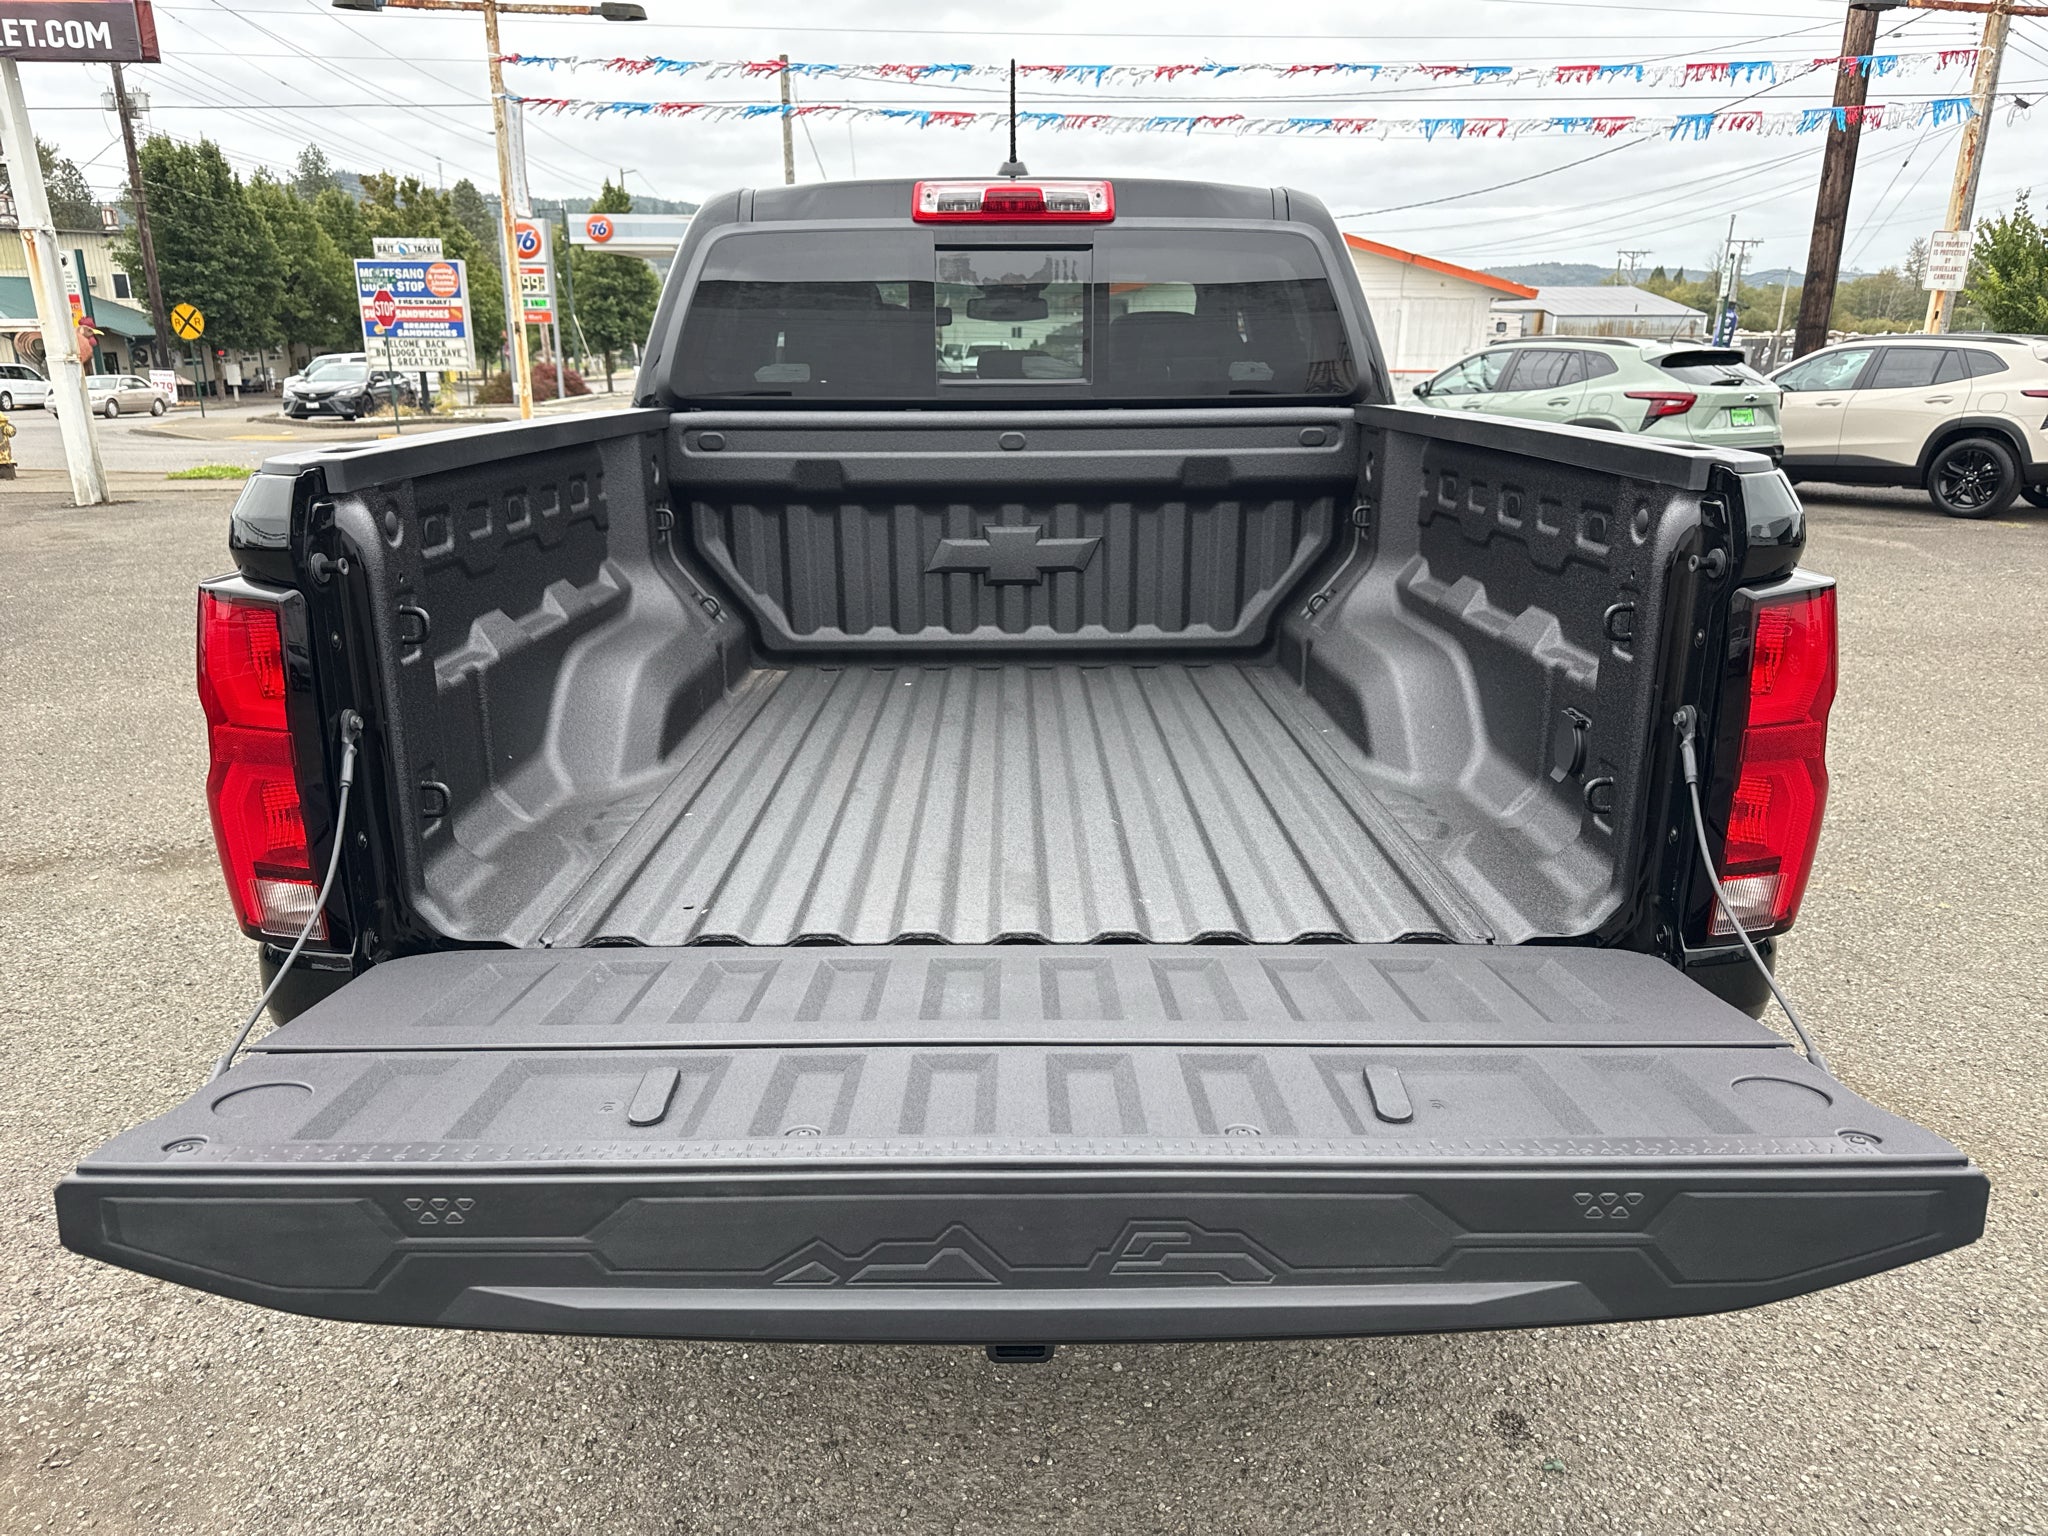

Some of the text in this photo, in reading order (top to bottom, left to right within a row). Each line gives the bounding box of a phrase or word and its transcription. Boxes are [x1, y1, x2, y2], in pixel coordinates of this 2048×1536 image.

[0, 19, 113, 50] ET.COM
[591, 222, 607, 236] 76
[377, 245, 440, 254] BAIT TACKLE
[1945, 241, 1969, 249] PROPERTY
[1939, 249, 1966, 257] PROTECTED
[1930, 265, 1963, 273] SURVEILLANCE
[397, 281, 425, 292] STOP
[374, 301, 395, 316] STOP
[395, 308, 450, 319] SANDWICHES
[174, 317, 201, 327] R R
[396, 328, 458, 337] SANDWICHES
[425, 340, 447, 348] BACK
[376, 348, 462, 357] BULDOGS LETS HAVE
[397, 357, 451, 366] GREAT YEAR
